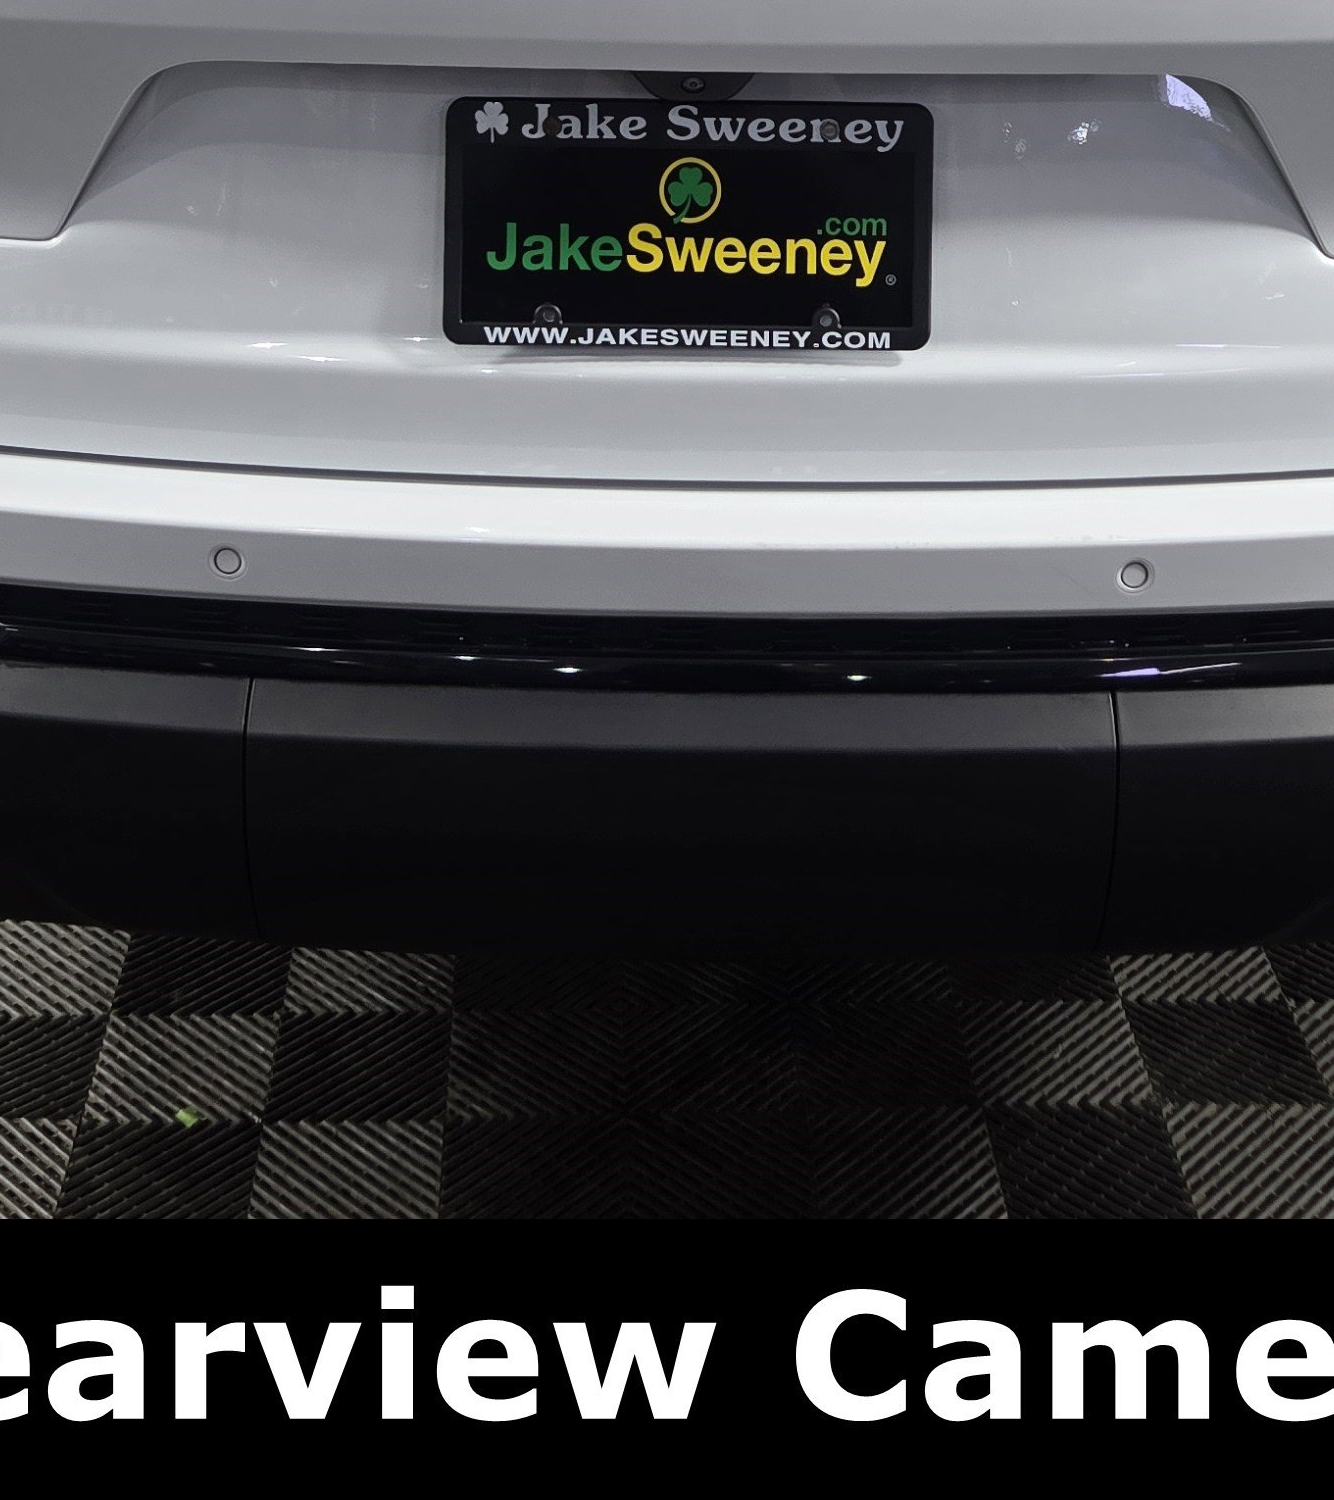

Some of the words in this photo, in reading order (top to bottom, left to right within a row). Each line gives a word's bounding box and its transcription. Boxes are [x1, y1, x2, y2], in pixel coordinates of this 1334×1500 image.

[521, 102, 648, 141] Jake
[666, 103, 905, 153] Sweeney
[484, 326, 892, 349] WWW.JAKESWEENEY.COM
